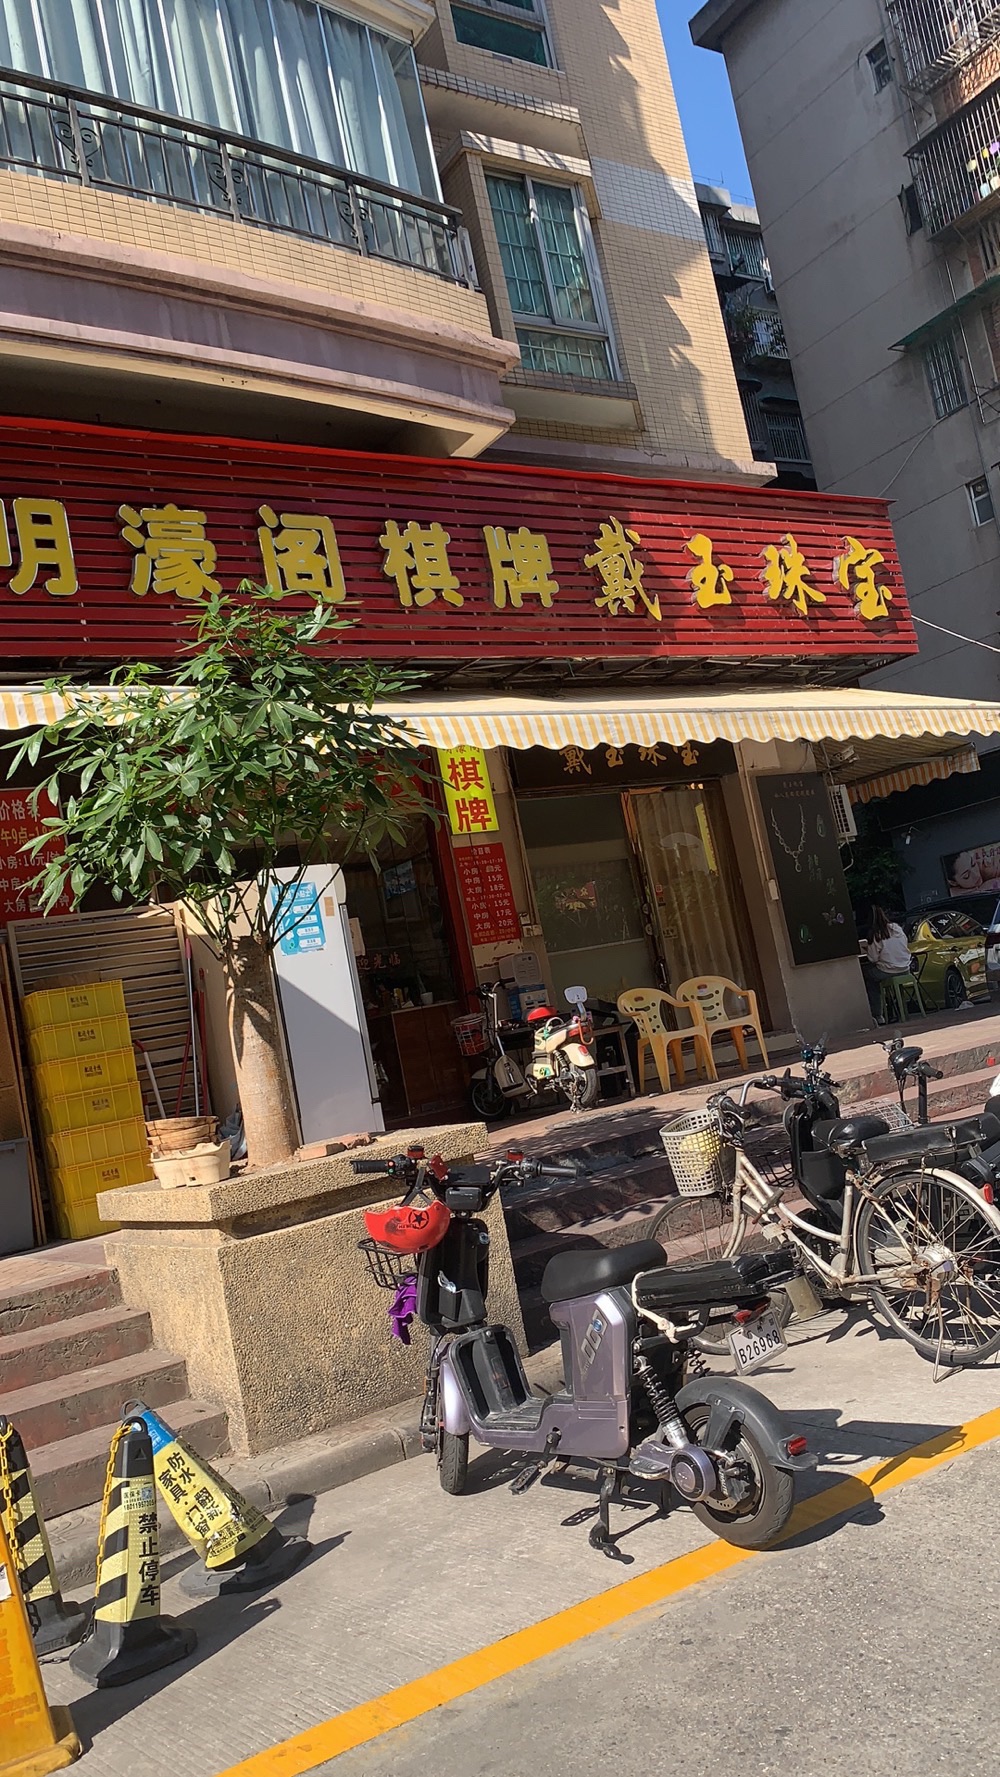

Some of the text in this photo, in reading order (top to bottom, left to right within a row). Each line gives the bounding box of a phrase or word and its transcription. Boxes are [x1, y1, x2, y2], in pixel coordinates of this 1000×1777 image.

[584, 515, 893, 622] 戴玉珠宝
[447, 756, 493, 833] 棋牌
[738, 1329, 780, 1365] B26968
[138, 1512, 161, 1607] 禁止停车
